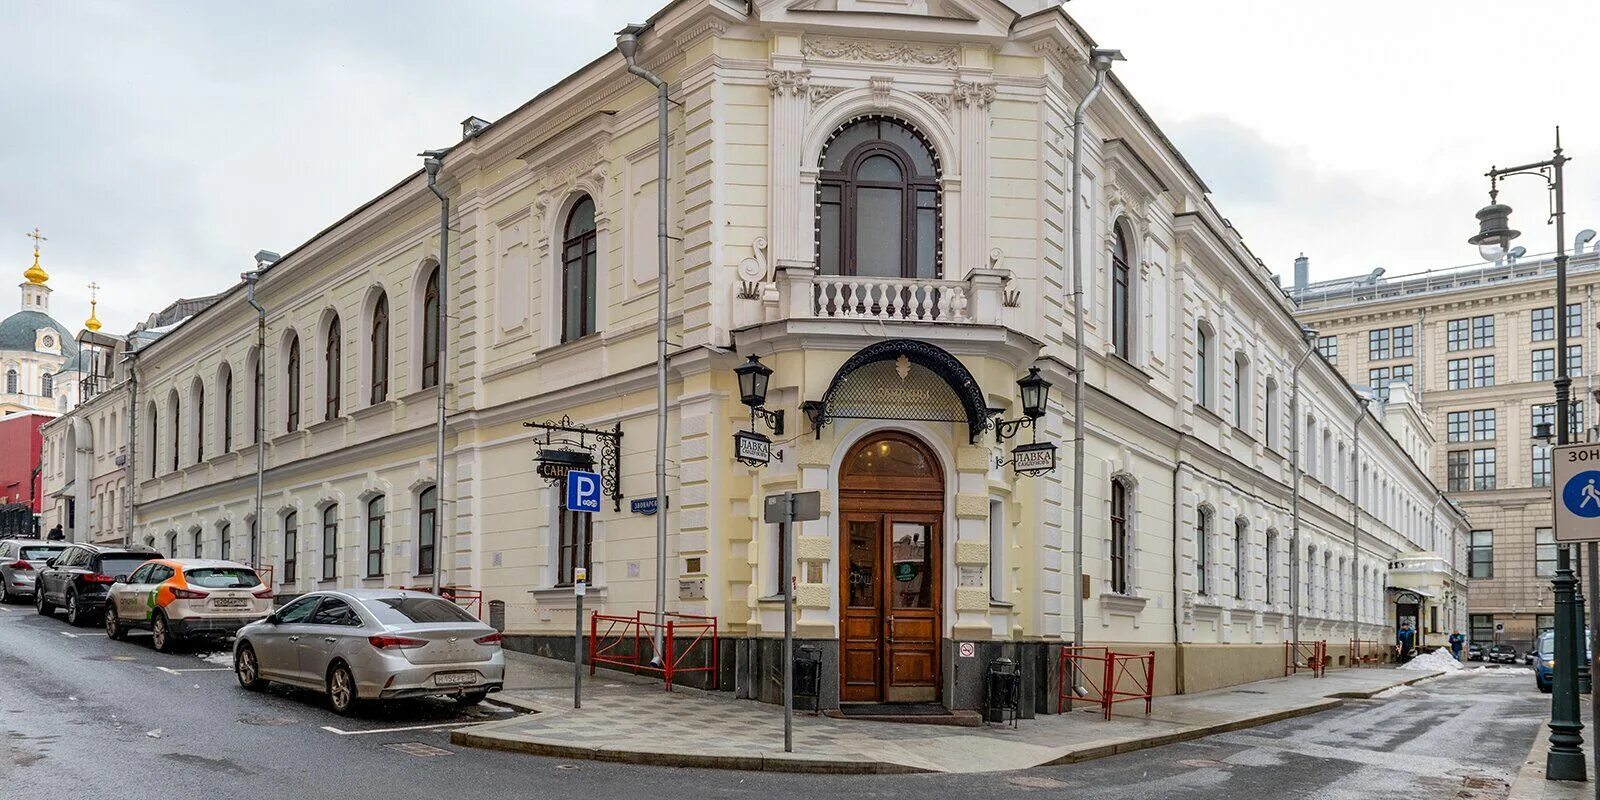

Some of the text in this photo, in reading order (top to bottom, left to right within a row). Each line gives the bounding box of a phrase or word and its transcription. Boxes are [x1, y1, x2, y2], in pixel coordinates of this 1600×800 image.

[740, 440, 768, 453] ЛАВКА
[1016, 451, 1051, 462] ЛАВКА
[1568, 449, 1600, 462] ЗОН
[577, 476, 595, 506] P
